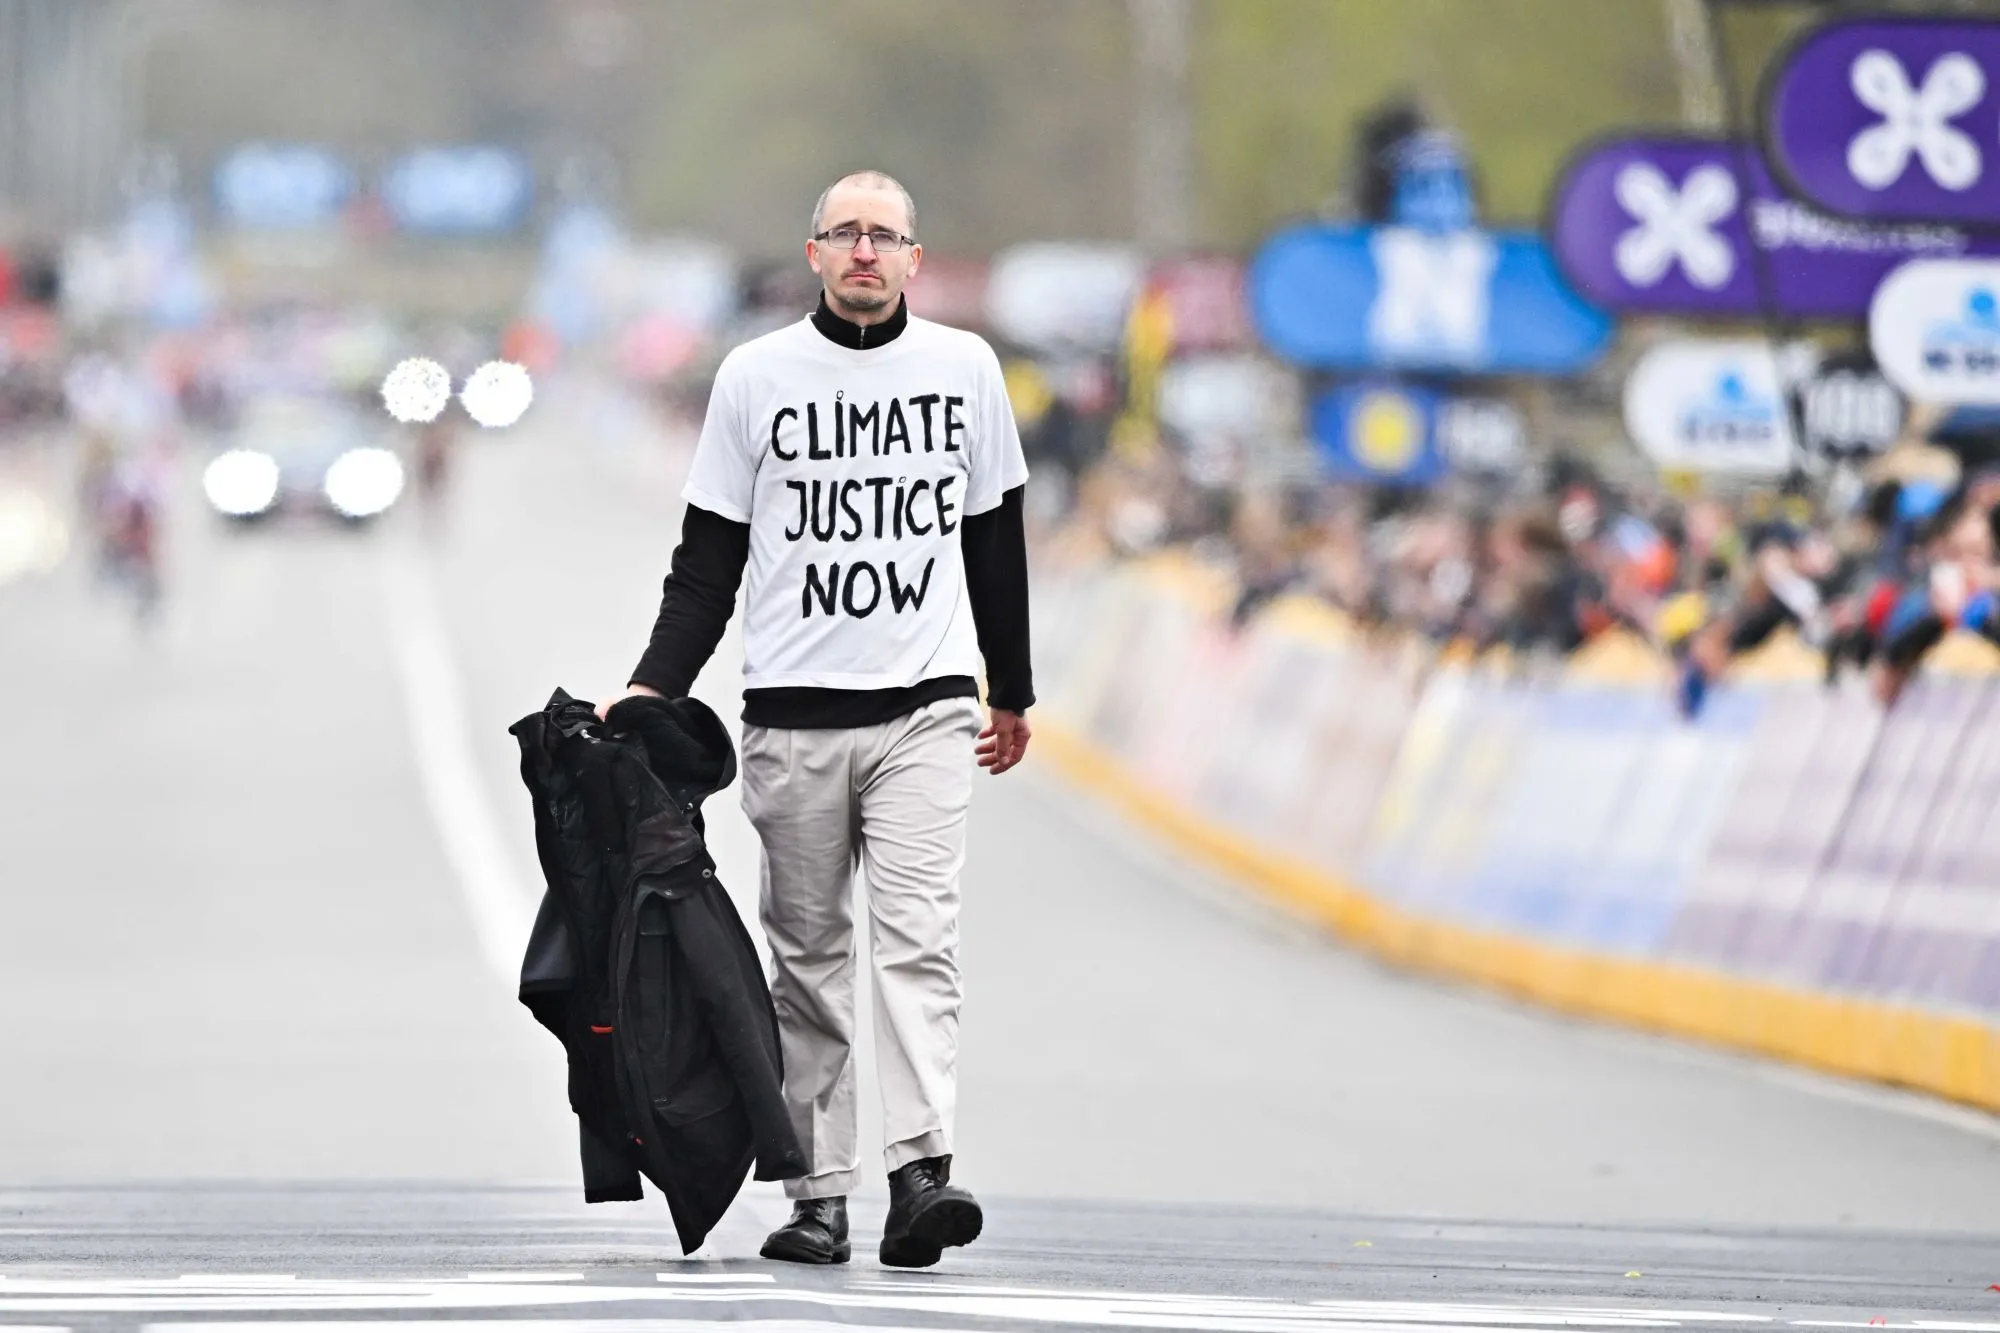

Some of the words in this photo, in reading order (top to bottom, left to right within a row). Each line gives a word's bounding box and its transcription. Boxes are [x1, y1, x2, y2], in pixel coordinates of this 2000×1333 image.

[771, 390, 965, 461] CLIMATE
[785, 475, 957, 542] JUSTICE
[802, 557, 935, 619] NOW
